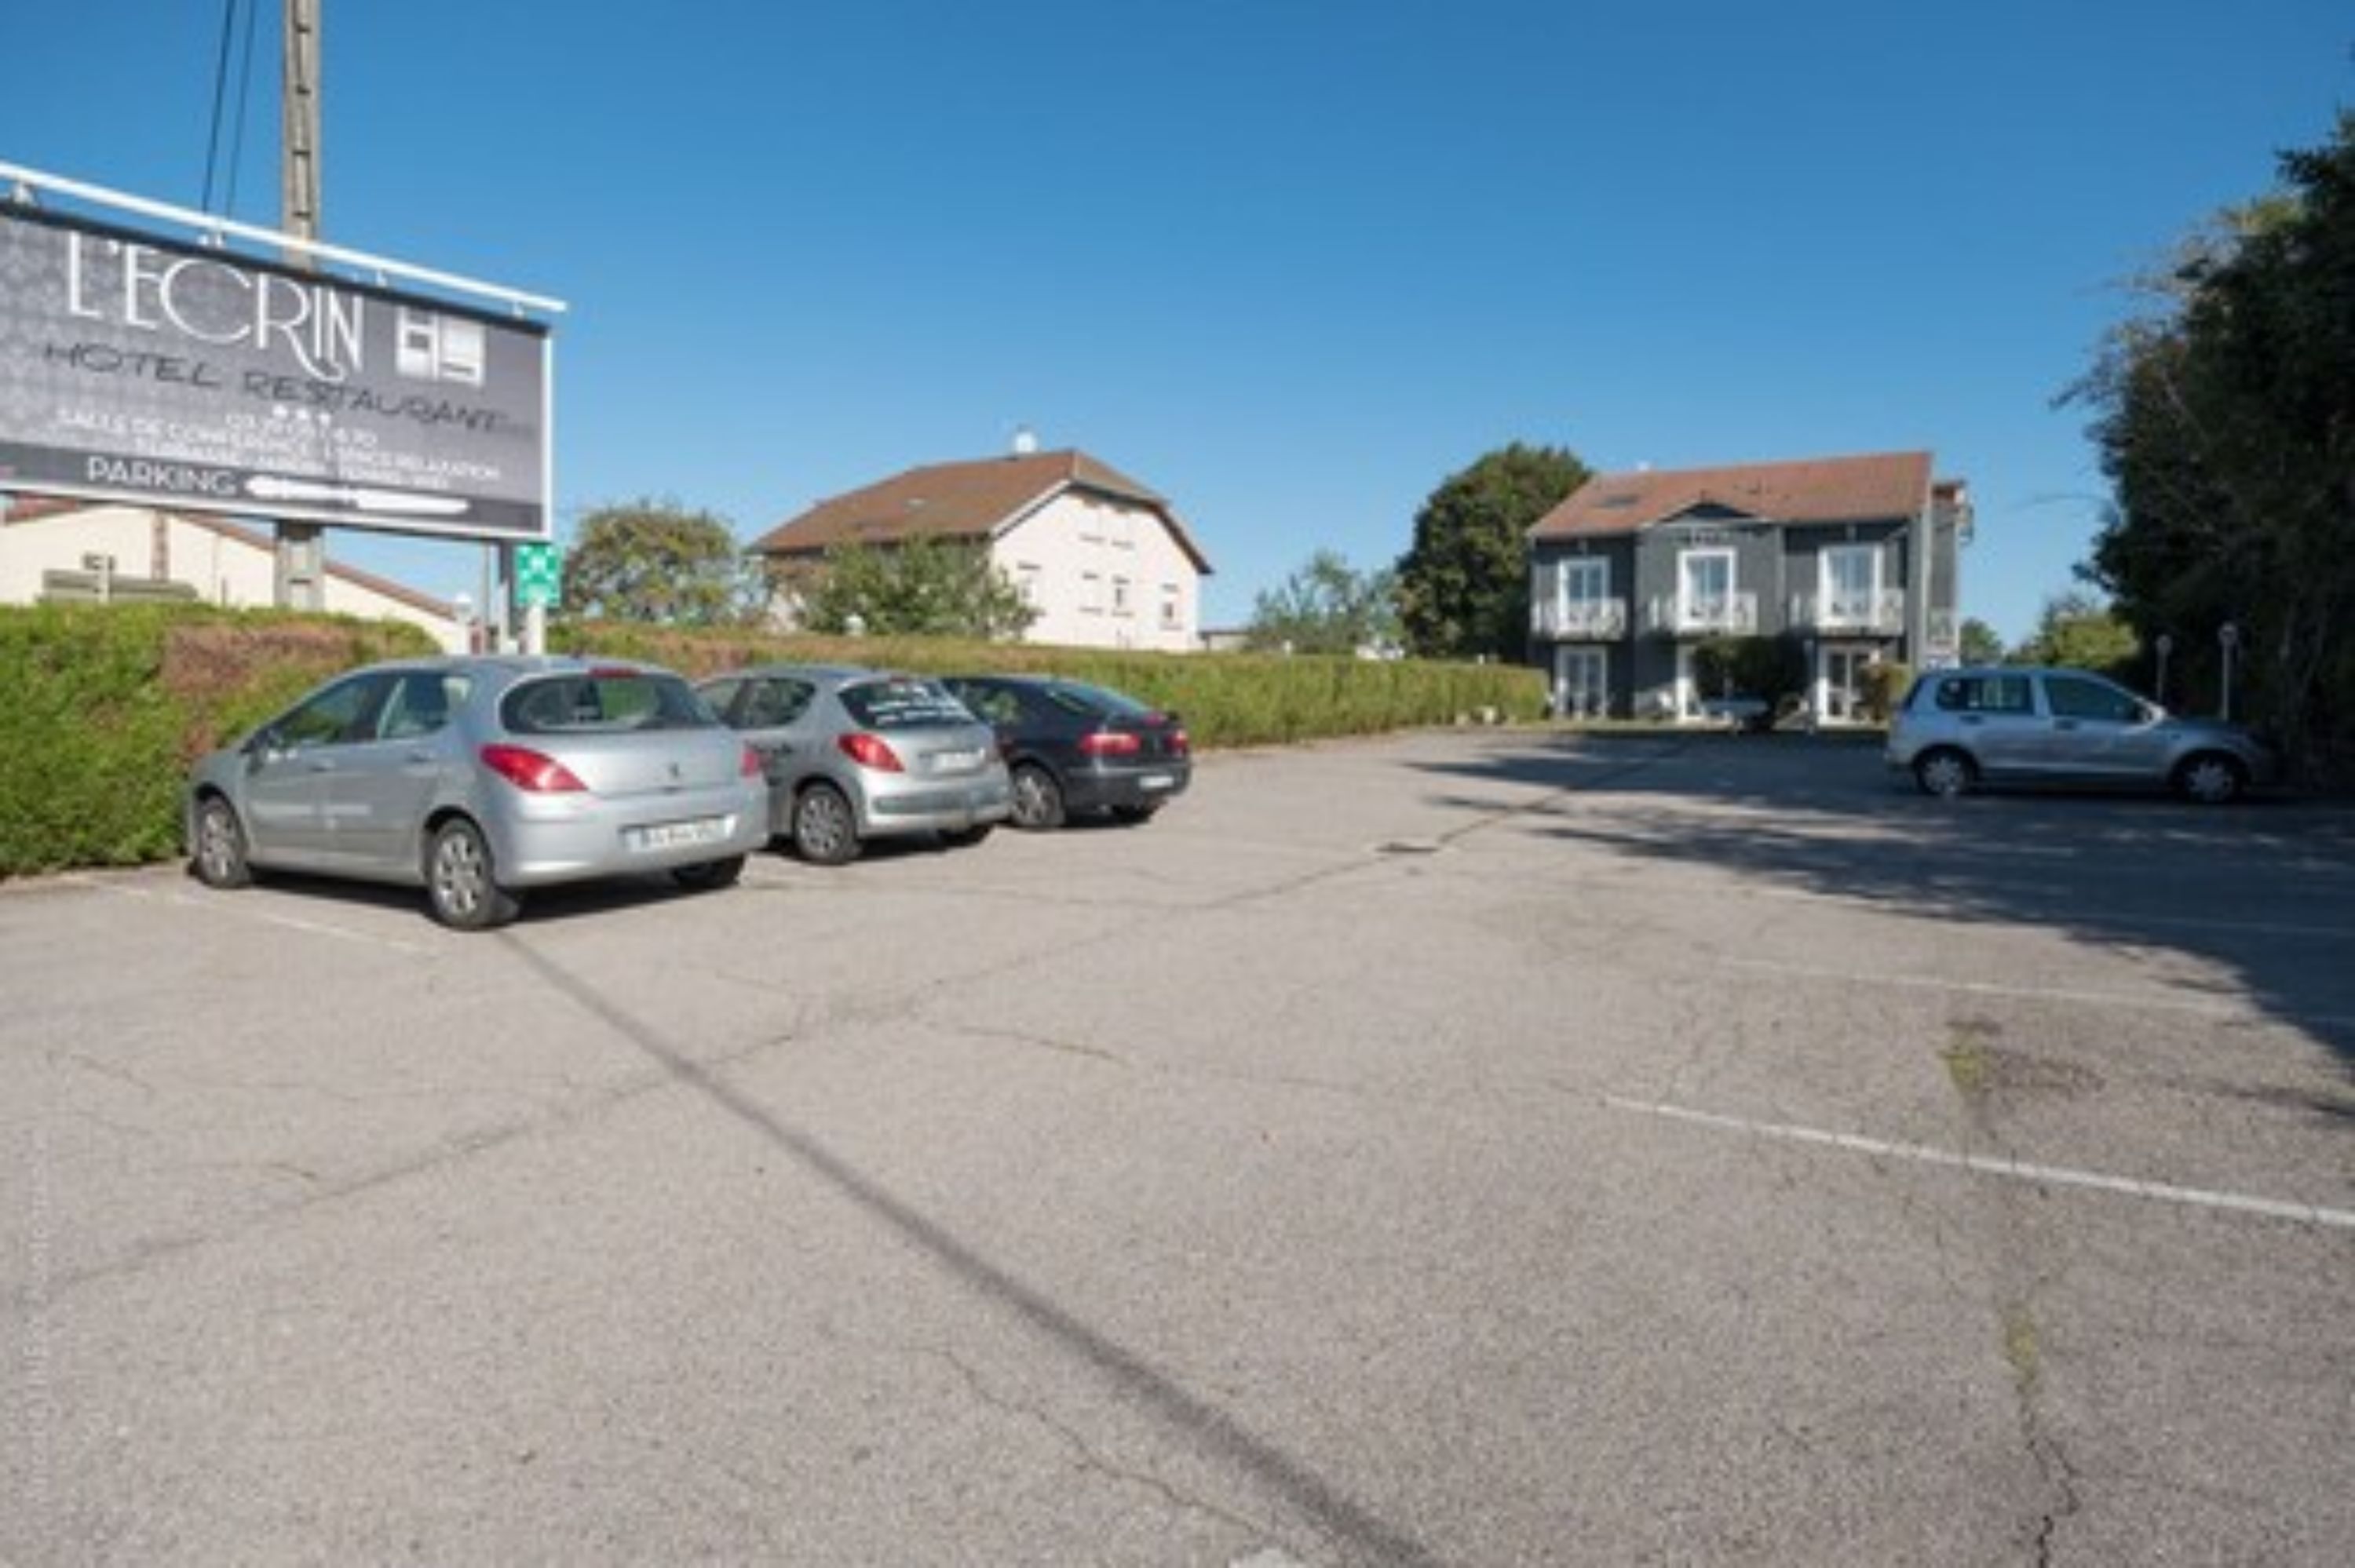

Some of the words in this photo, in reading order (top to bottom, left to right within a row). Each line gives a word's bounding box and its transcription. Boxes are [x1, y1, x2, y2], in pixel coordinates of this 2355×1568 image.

[46, 341, 222, 387] HOTEL
[243, 370, 510, 434] RESTAURANT
[87, 455, 237, 496] PARKING
